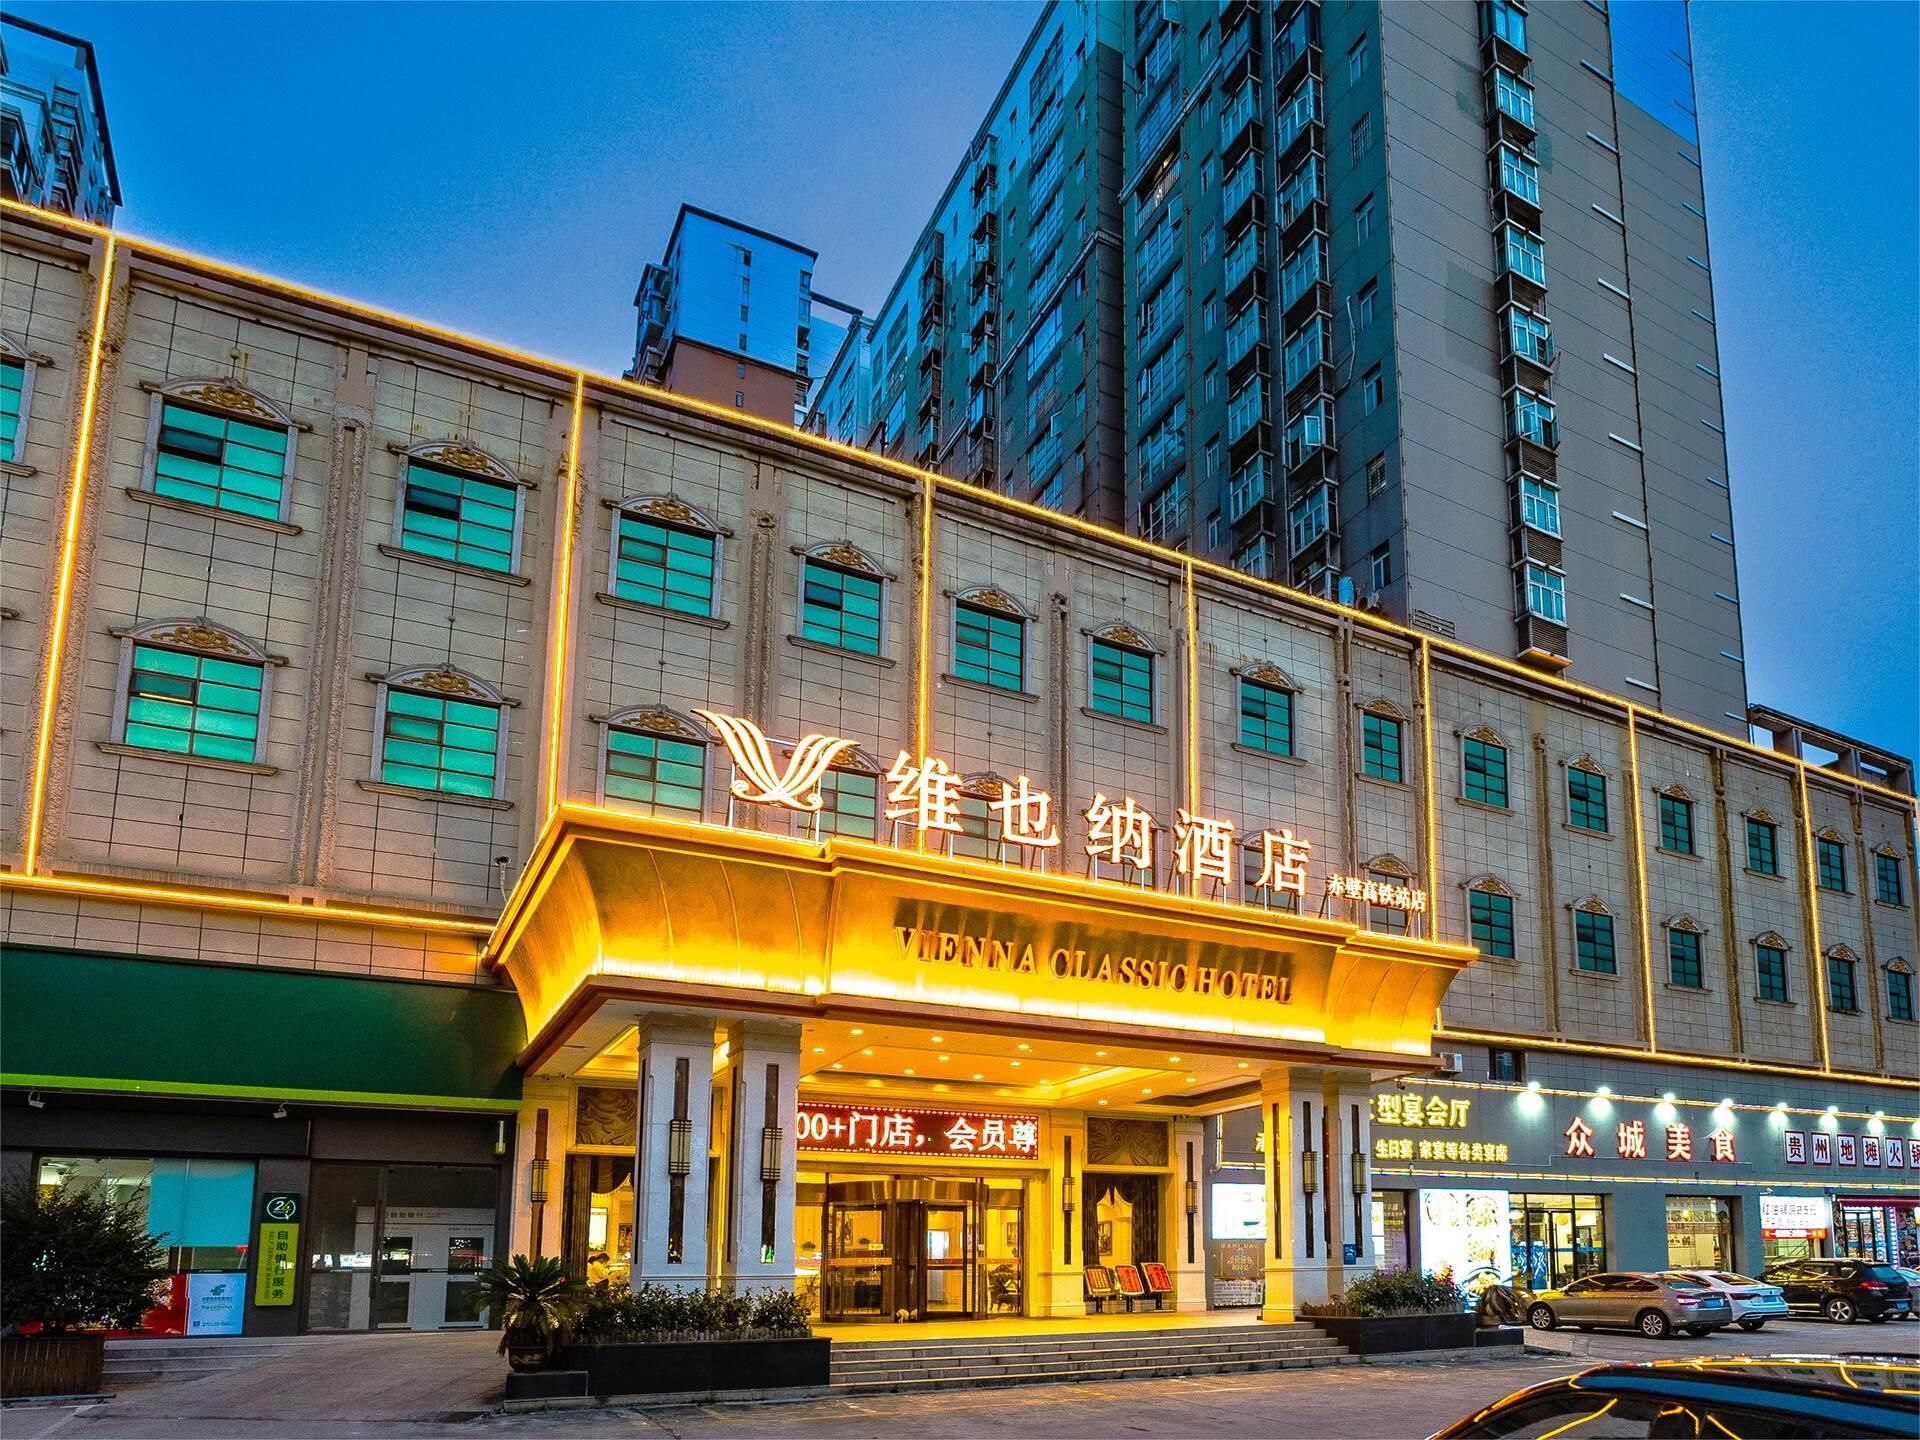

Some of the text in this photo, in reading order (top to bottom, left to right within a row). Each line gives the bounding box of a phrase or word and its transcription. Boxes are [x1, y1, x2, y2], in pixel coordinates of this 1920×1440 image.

[884, 750, 1312, 896] 维也纳酒店
[1326, 873, 1427, 912] 赤壁高铁站店
[893, 926, 1294, 1004] VIENNA CLASSIC HOTEL
[1370, 1093, 1471, 1128] 型宴会厅
[1375, 1138, 1509, 1163] 生日宴 家宴等各类宴席
[1563, 1116, 1736, 1163] 众城美食
